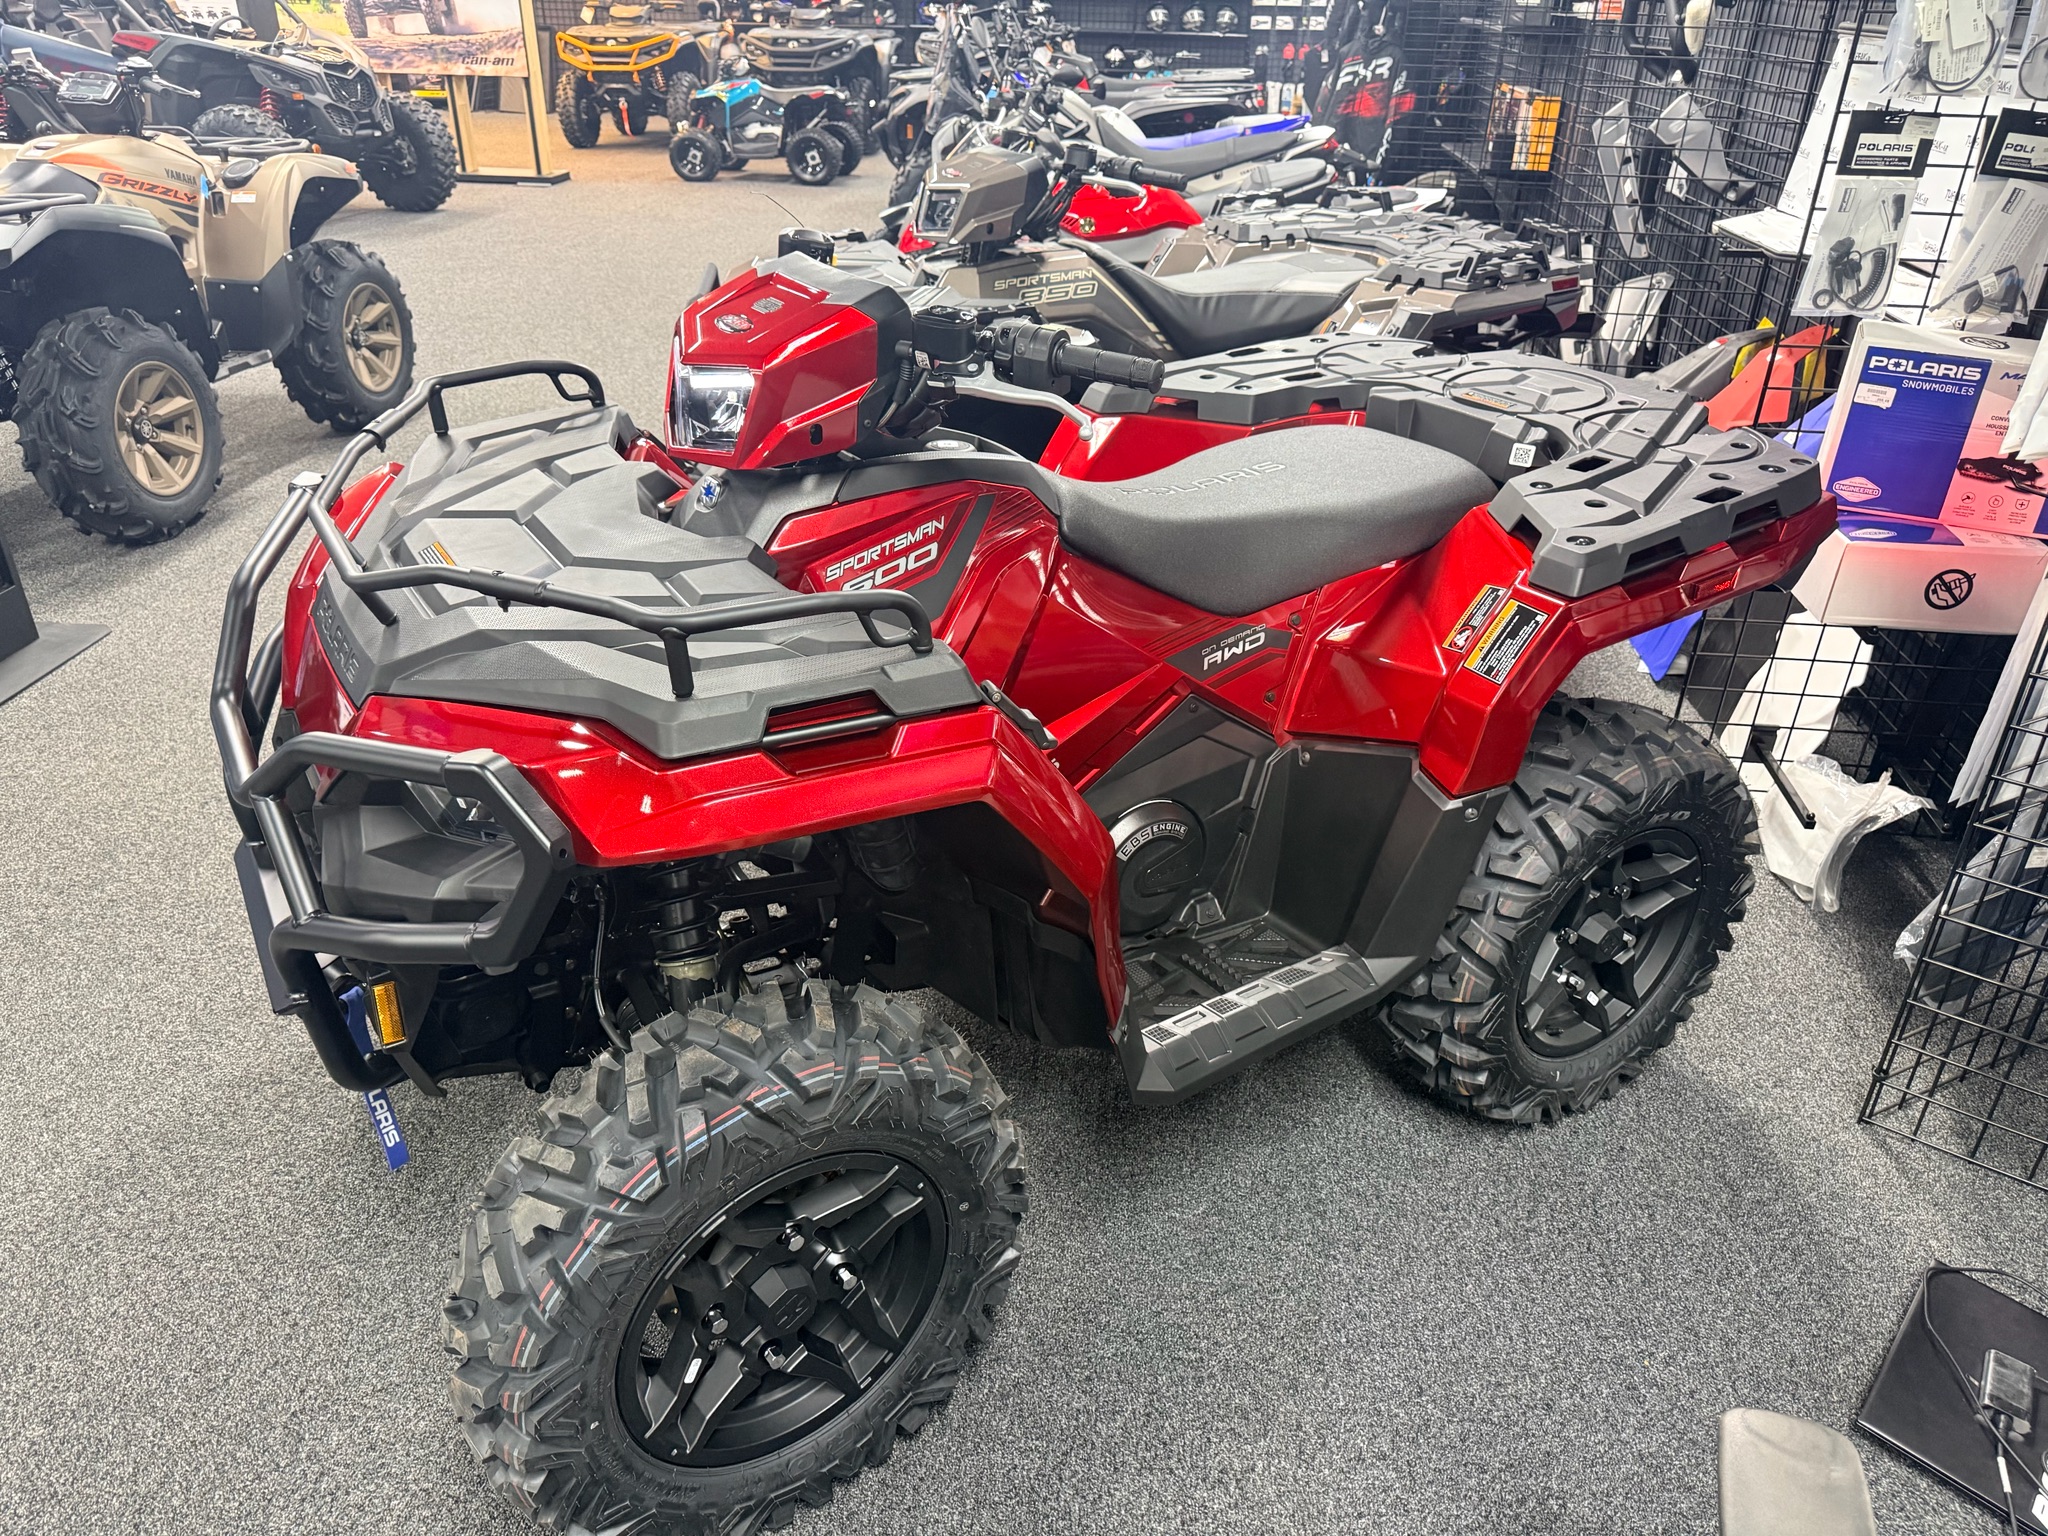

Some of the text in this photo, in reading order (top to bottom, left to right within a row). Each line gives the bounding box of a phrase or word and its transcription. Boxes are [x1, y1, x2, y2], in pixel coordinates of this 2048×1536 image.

[461, 56, 515, 66] can-am
[1336, 57, 1393, 91] FXR
[1858, 143, 1914, 152] POLARIS
[98, 172, 197, 204] GRIZZLY
[164, 168, 197, 185] YAMAHA
[994, 269, 1093, 291] SPORTSMAN
[1019, 281, 1098, 304] 850
[1869, 356, 1982, 381] POLARIS
[1902, 380, 1975, 396] SNOWMOBILES
[1113, 461, 1287, 496] POLARIS
[1835, 483, 1879, 496] ENGINEERED
[826, 515, 945, 582] SPORTSMAN
[1483, 615, 1505, 646] WARNING
[1203, 631, 1266, 671] AWD
[1120, 823, 1186, 857] EBS ENGINE
